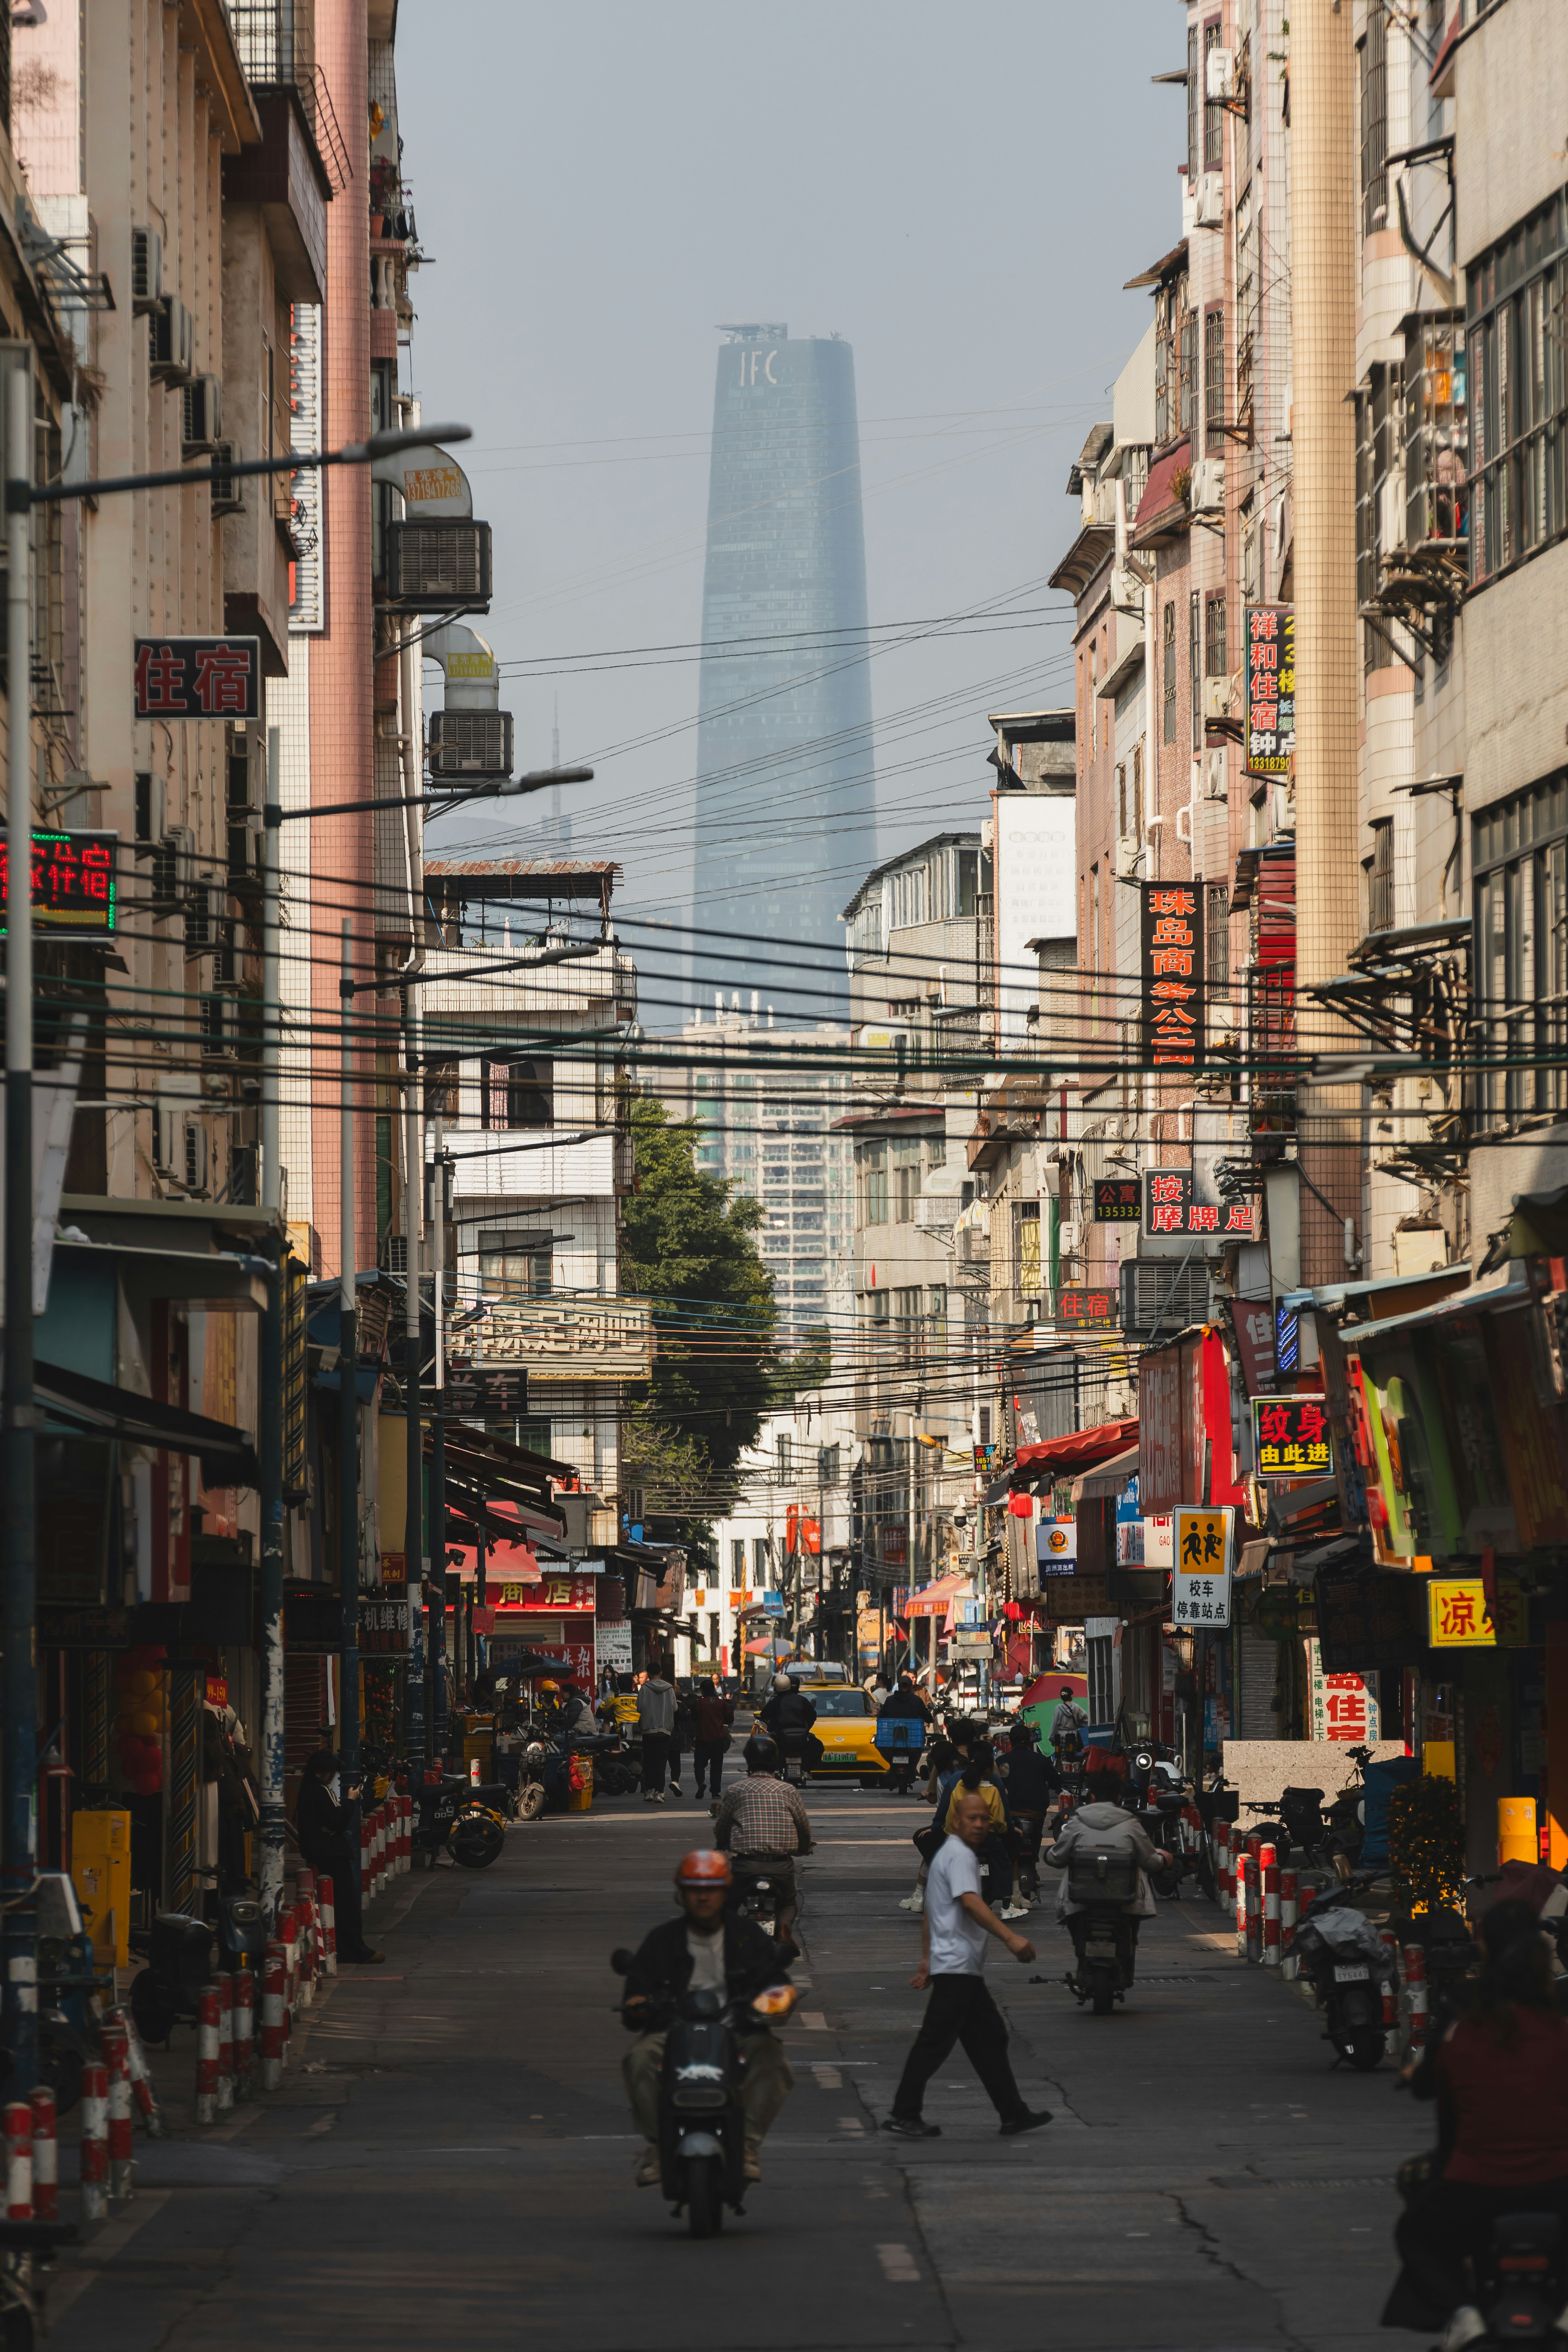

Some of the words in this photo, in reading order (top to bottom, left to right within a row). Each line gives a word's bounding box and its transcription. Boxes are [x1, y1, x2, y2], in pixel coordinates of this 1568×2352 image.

[740, 350, 778, 386] IFC
[406, 468, 459, 482] 星光冷气
[406, 481, 461, 500] 13719417266
[447, 666, 492, 675] 13719417266
[449, 654, 491, 665] 星光冷气
[1250, 611, 1278, 730] 祥和住宿
[135, 644, 250, 713] 住宿
[1149, 887, 1196, 1066] 珠岛商务公寓
[1099, 1184, 1142, 1204] 公寓
[1098, 1206, 1141, 1217] 135332
[1061, 1293, 1109, 1318] 住宿
[1260, 1403, 1327, 1444] 纹身
[1260, 1443, 1329, 1464] 由此进
[1159, 1536, 1170, 1546] GAO
[1190, 1580, 1213, 1598] 校车
[358, 1605, 408, 1631] 机维修
[1177, 1601, 1226, 1619] 停靠站点
[1314, 1644, 1323, 1690] 请上二楼
[1368, 1673, 1377, 1698] 月租
[1315, 1697, 1324, 1741] 电梯上下
[1368, 1703, 1378, 1741] 钟点房
[1338, 1970, 1368, 1981] SY5442
